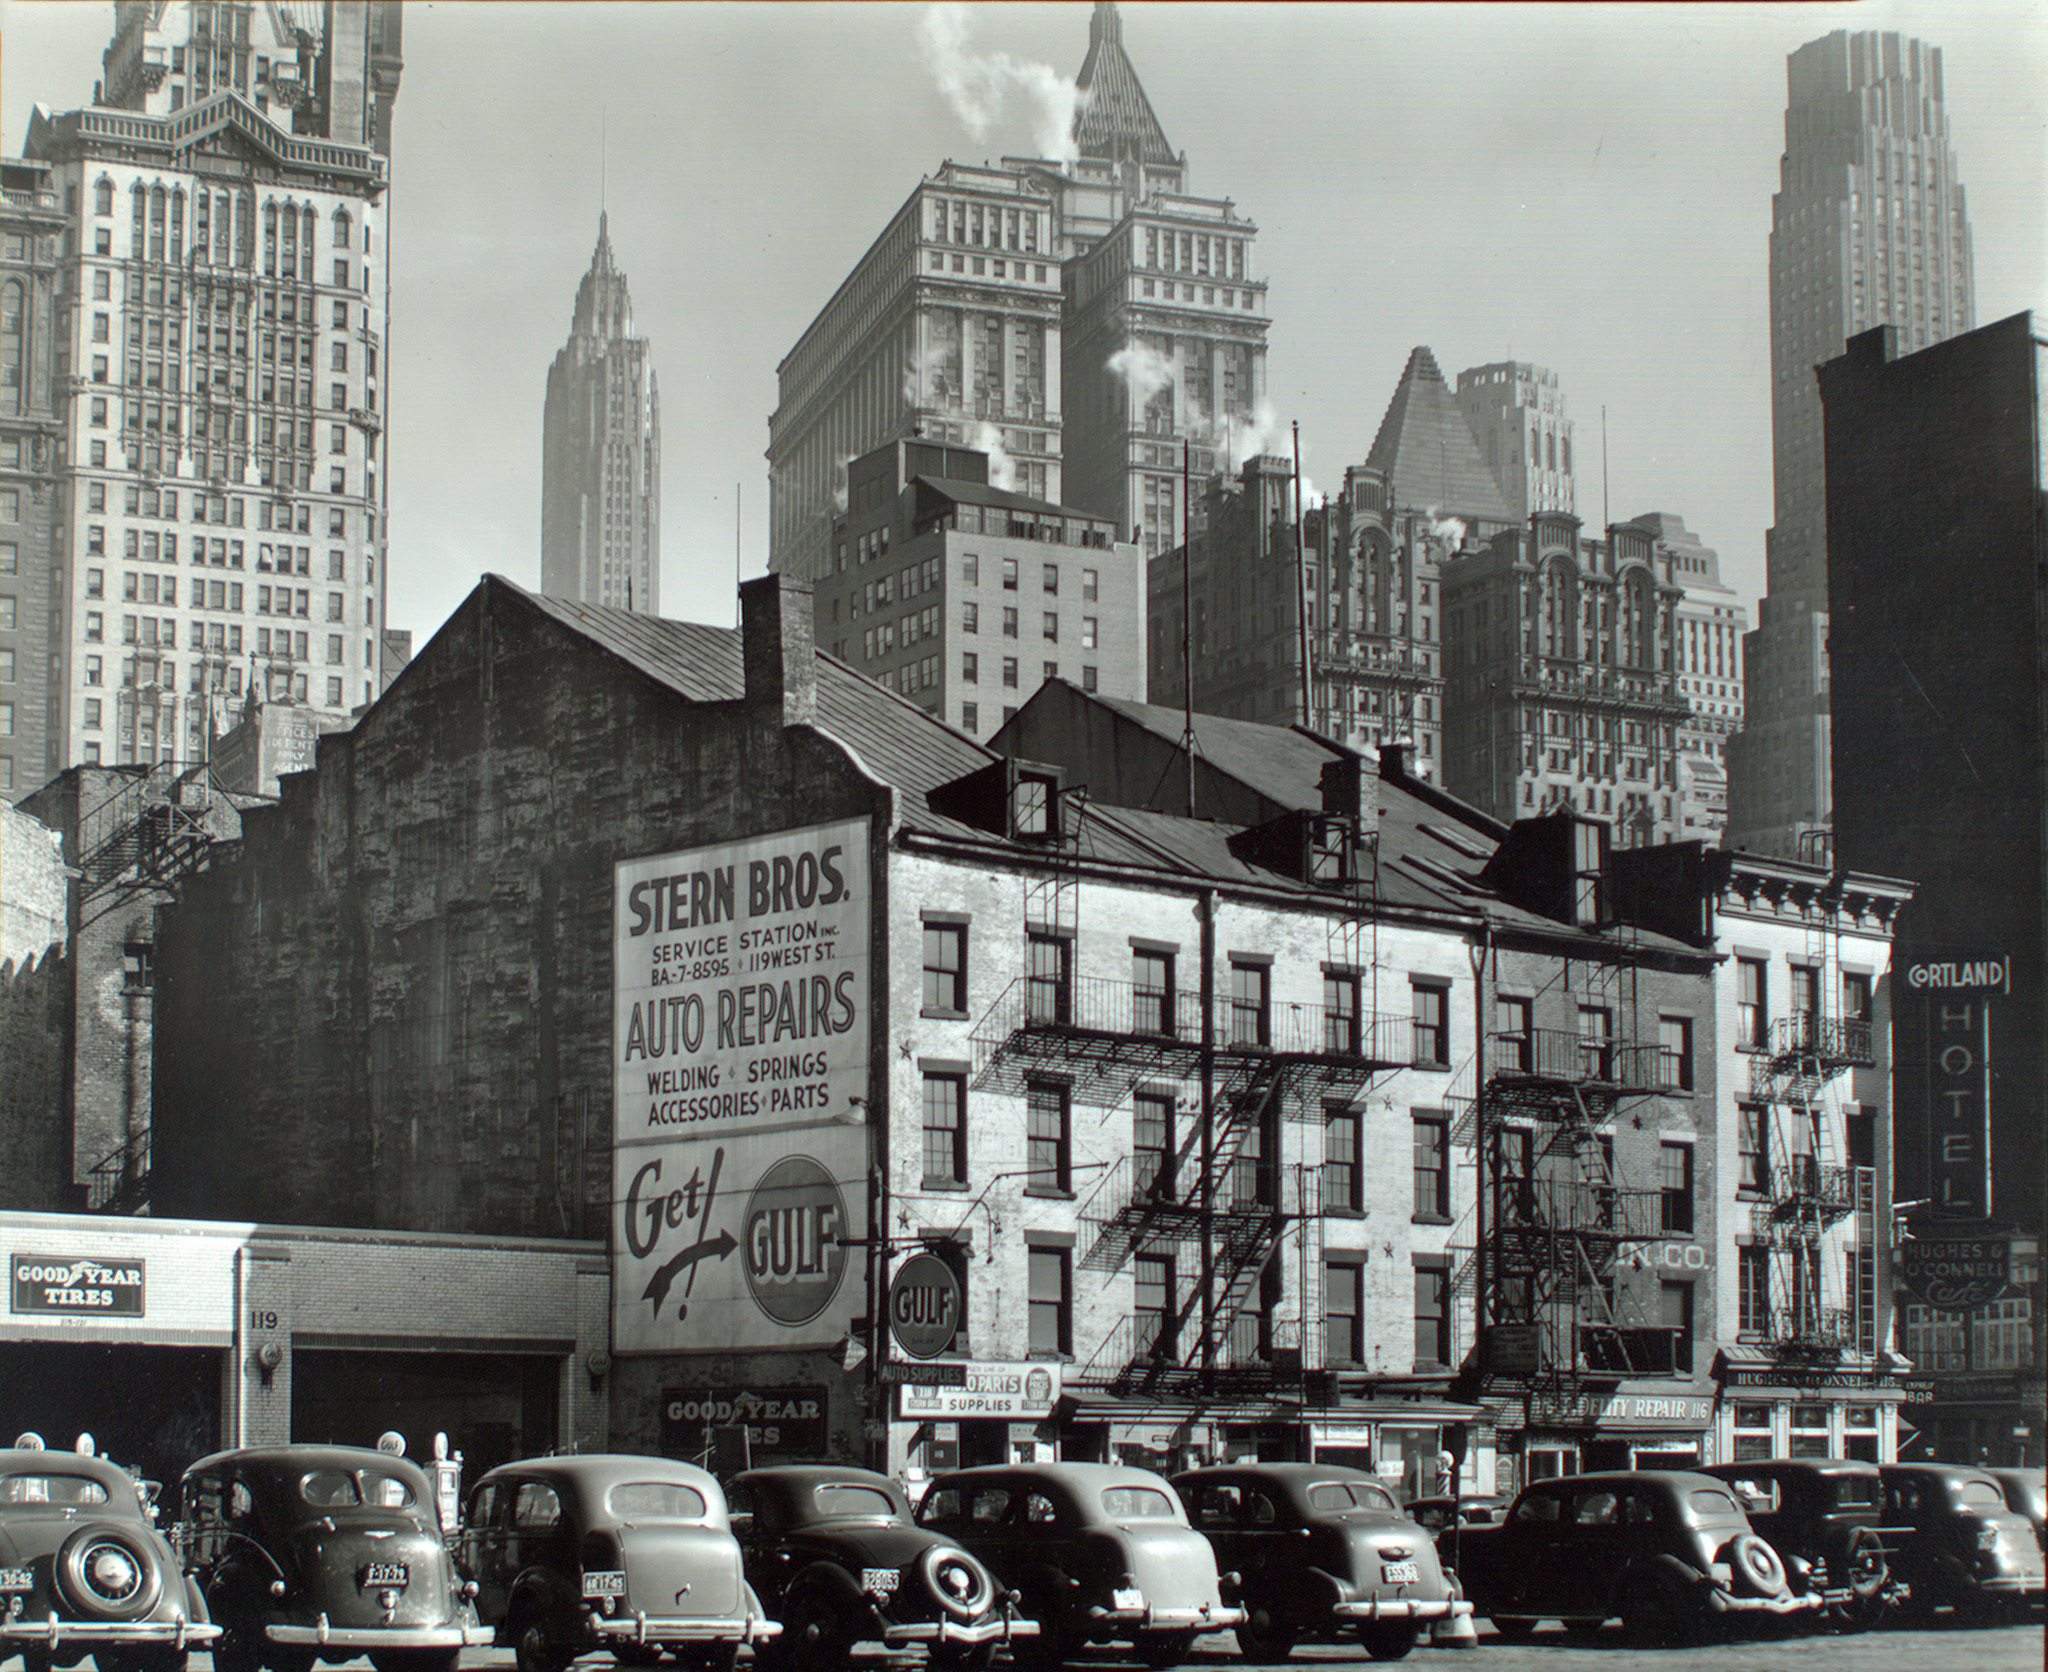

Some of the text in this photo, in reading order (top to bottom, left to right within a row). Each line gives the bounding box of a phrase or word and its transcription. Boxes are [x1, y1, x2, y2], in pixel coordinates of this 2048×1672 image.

[629, 845, 850, 937] STERN BROS.
[653, 920, 840, 964] SERVICE STATION INC.
[815, 942, 836, 961] ST.
[1908, 961, 2003, 988] CORTLAND
[625, 971, 856, 1062] AUTO REPAIRS
[647, 1051, 828, 1096] WELDING SPRINGS
[648, 1083, 829, 1127] ACCESSORIES PARTS
[1940, 1003, 1973, 1206] HOTEL
[749, 1203, 840, 1284] GULF
[1907, 1244, 1982, 1259] HUGHES
[44, 1288, 114, 1306] TIRES
[895, 1286, 954, 1328] GULF
[252, 1311, 279, 1330] 119
[881, 1364, 962, 1385] AUTO SUPPLIES
[977, 1375, 1020, 1393] PARTS
[949, 1399, 1012, 1411] SUPPLIES
[1907, 1390, 1933, 1404] BAR
[1634, 1400, 1688, 1419] REPAIR
[1692, 1401, 1708, 1418] 116
[701, 1426, 780, 1446] TES
